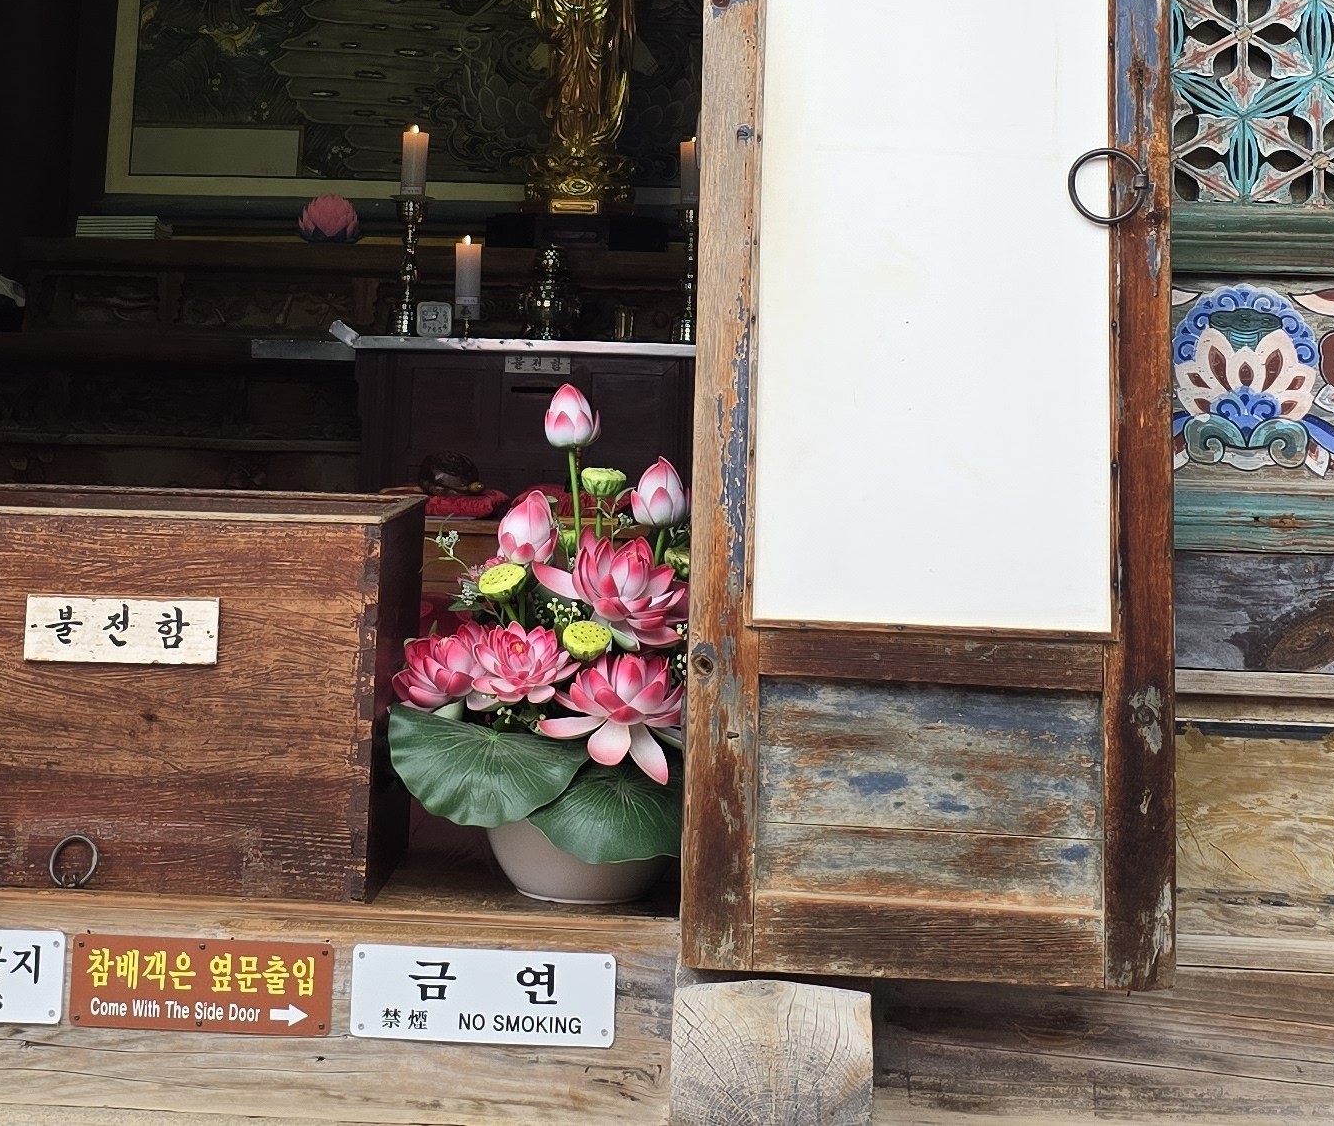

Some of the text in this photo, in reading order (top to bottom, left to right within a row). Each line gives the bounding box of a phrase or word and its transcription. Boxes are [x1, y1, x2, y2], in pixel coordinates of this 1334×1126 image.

[87, 947, 315, 996] 참배객은 옆문출입
[90, 996, 261, 1022] Come With The Side Door
[458, 1012, 583, 1035] NO SMOKING
